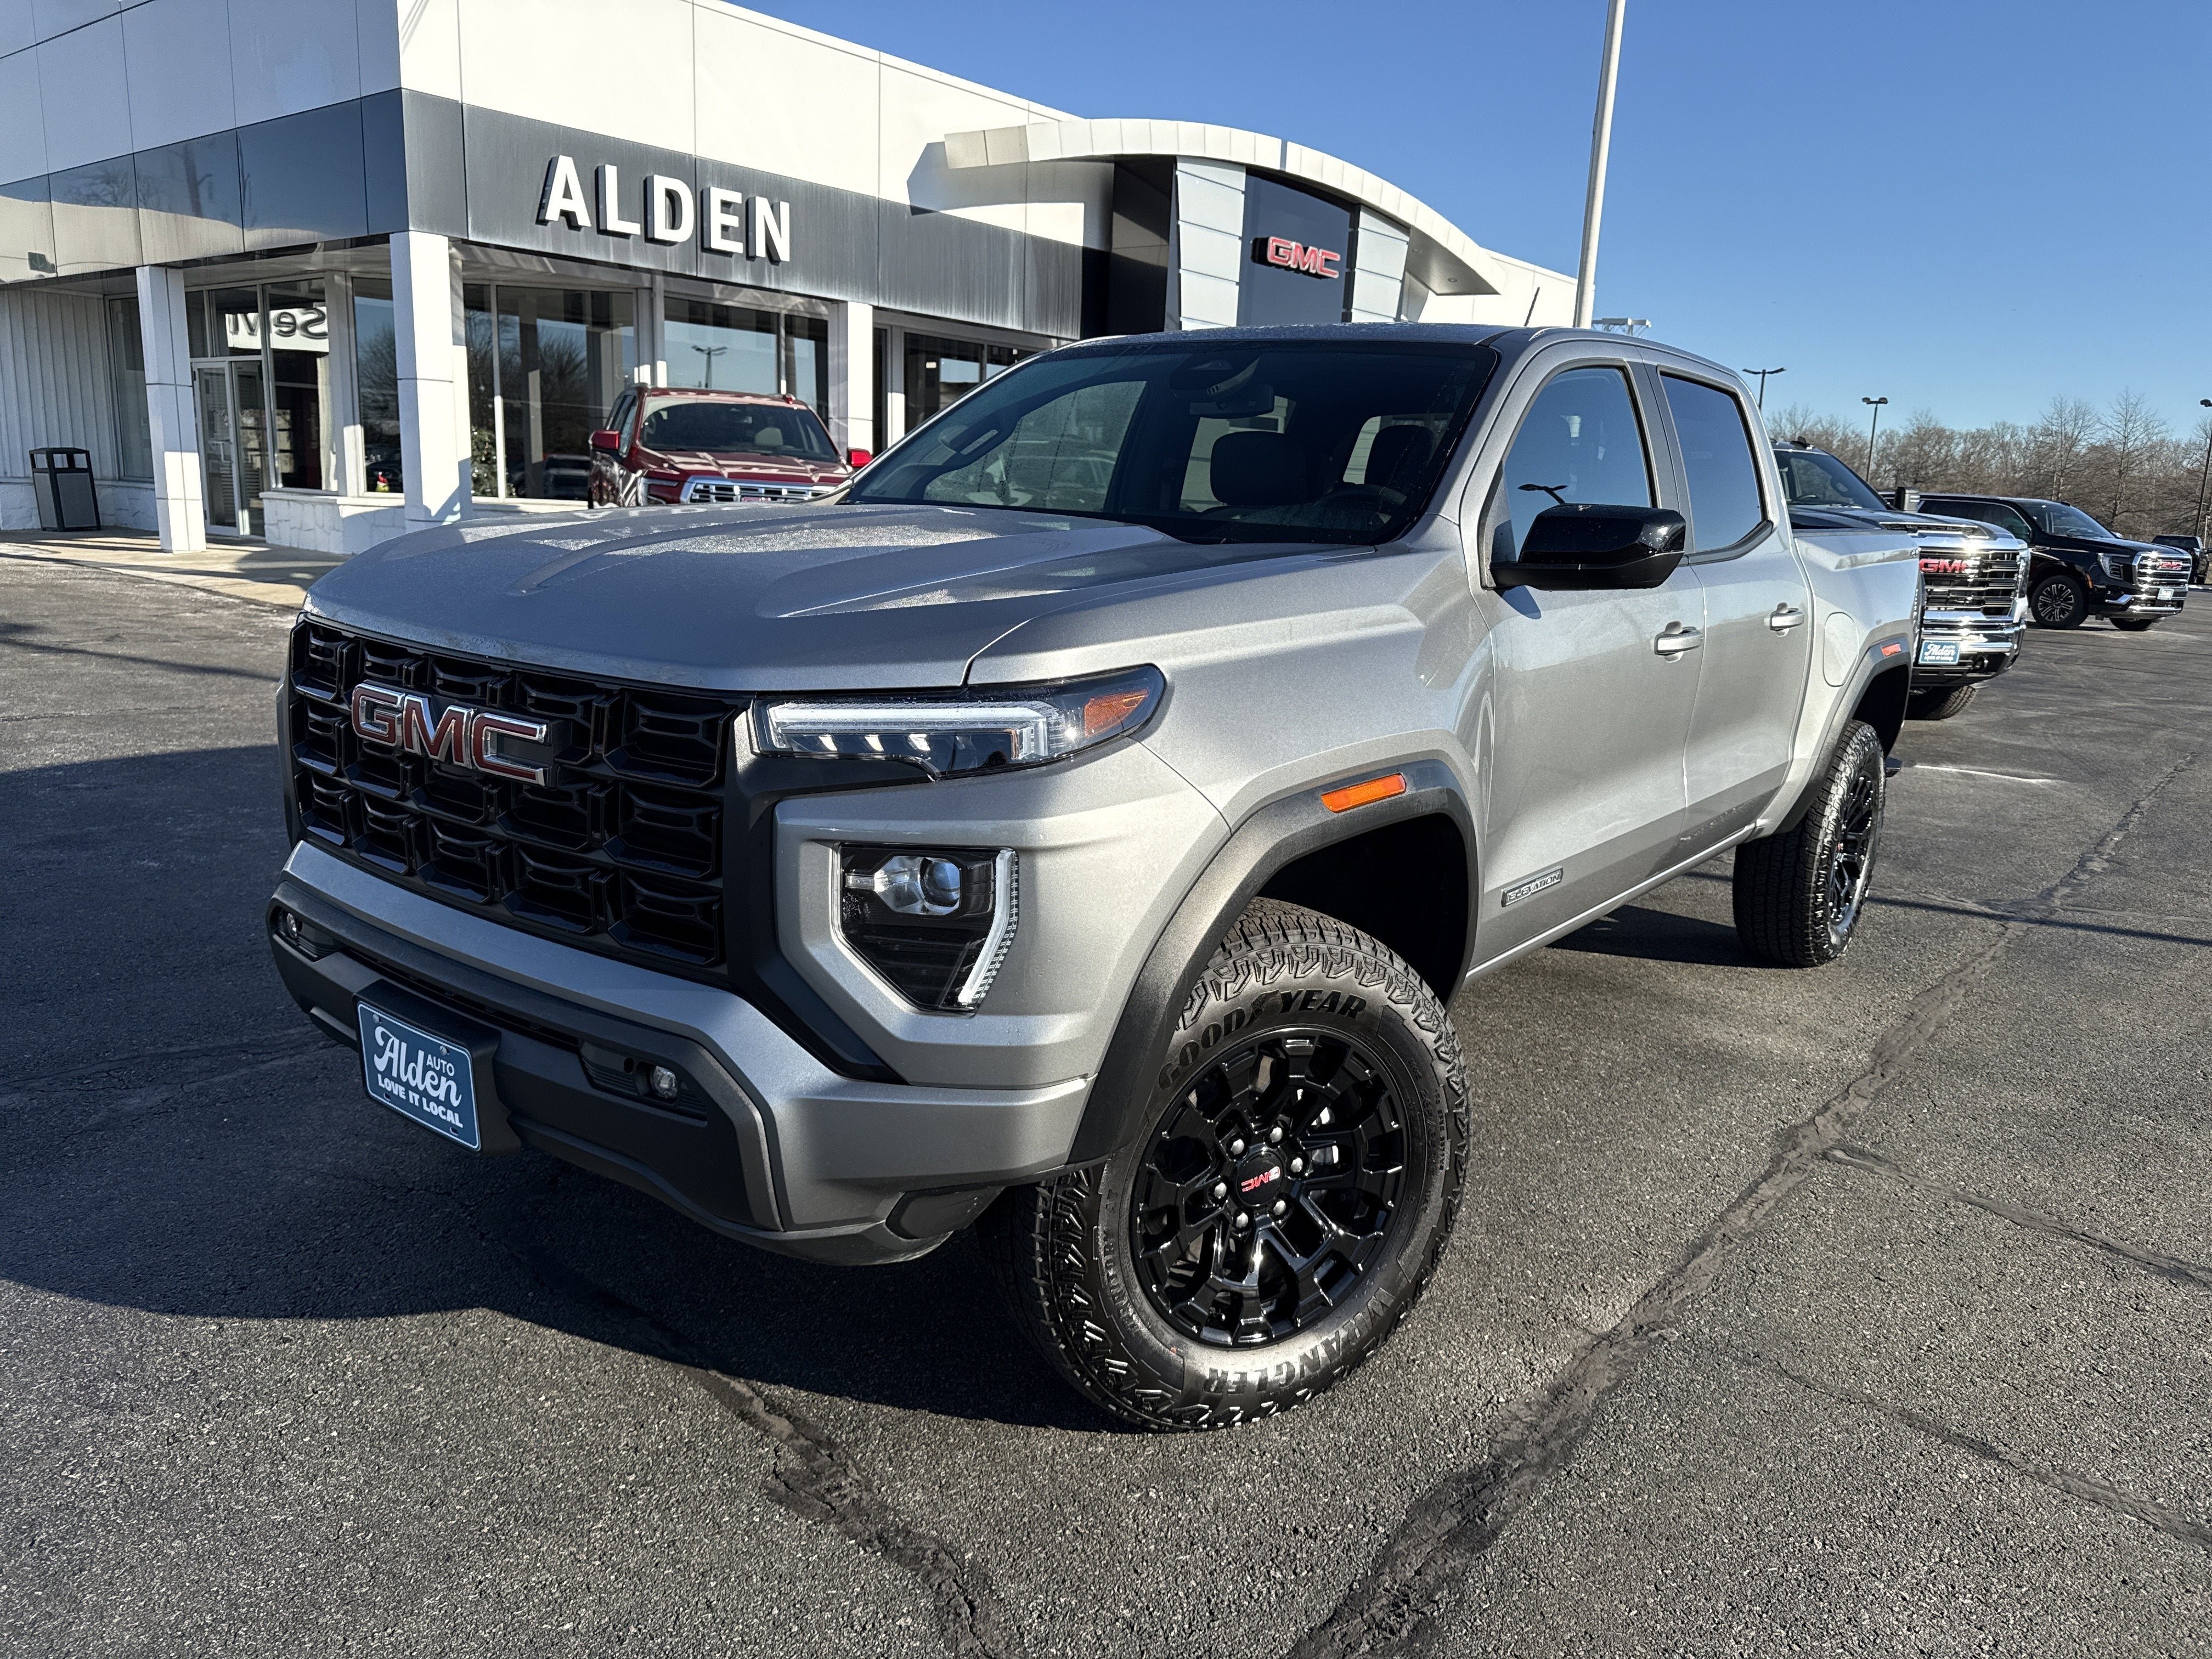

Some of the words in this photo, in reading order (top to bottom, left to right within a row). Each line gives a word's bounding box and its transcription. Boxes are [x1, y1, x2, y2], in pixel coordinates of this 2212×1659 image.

[542, 155, 790, 262] ALDEN
[1267, 236, 1341, 279] GMC
[352, 682, 548, 787] GMC
[1509, 871, 1561, 901] ELEVATION
[374, 1026, 462, 1107] Alden
[426, 1054, 455, 1076] AUTO
[377, 1074, 406, 1099] LOVE
[408, 1090, 420, 1107] IT
[422, 1097, 463, 1128] LOCAL
[1241, 1166, 1280, 1193] GMC
[1202, 1287, 1396, 1395] WRANGLER
